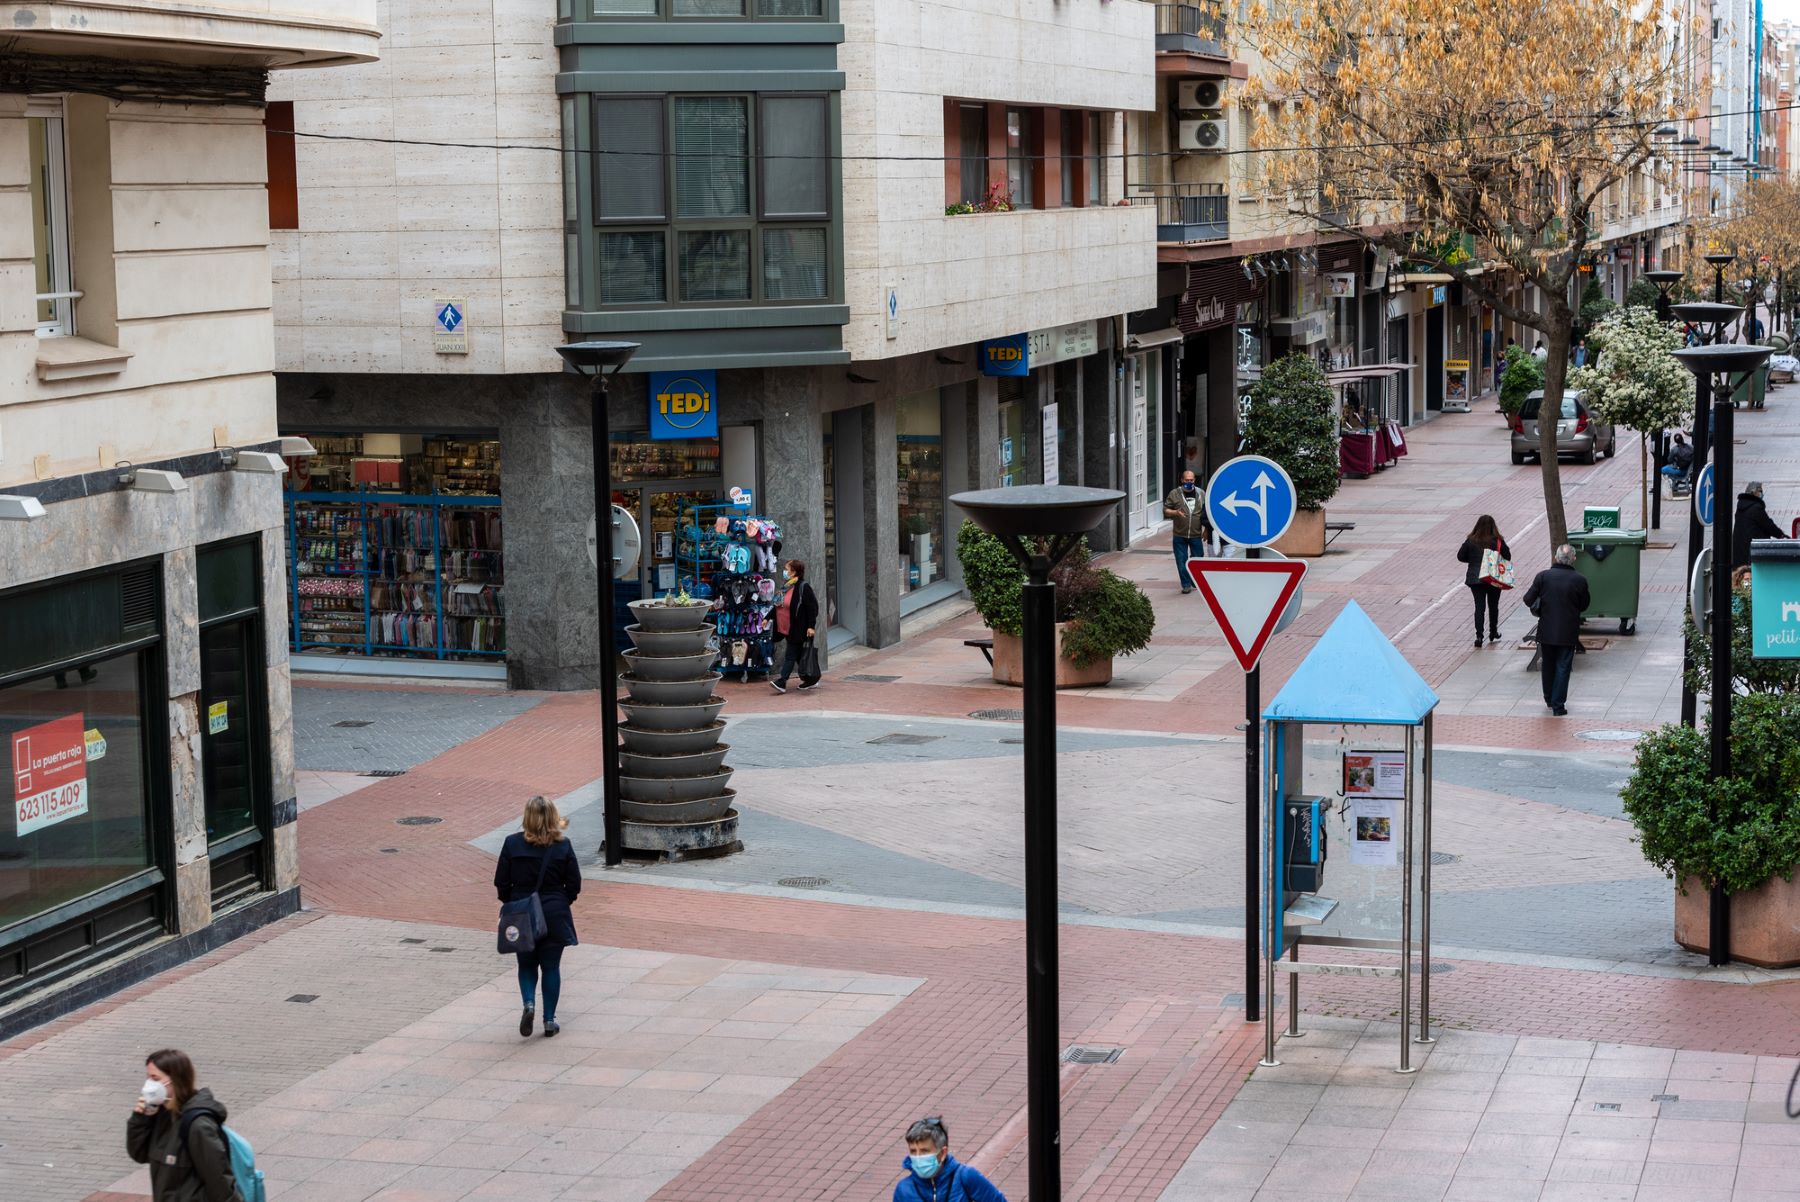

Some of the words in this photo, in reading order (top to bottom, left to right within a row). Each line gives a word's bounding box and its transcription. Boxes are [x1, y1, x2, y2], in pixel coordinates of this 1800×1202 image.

[988, 347, 1023, 361] TEDi
[656, 391, 710, 414] TEDi
[32, 759, 42, 770] La
[43, 752, 67, 769] puerta
[67, 744, 82, 759] roja
[19, 798, 40, 822] 623
[41, 791, 58, 814] 115
[60, 783, 80, 807] 409
